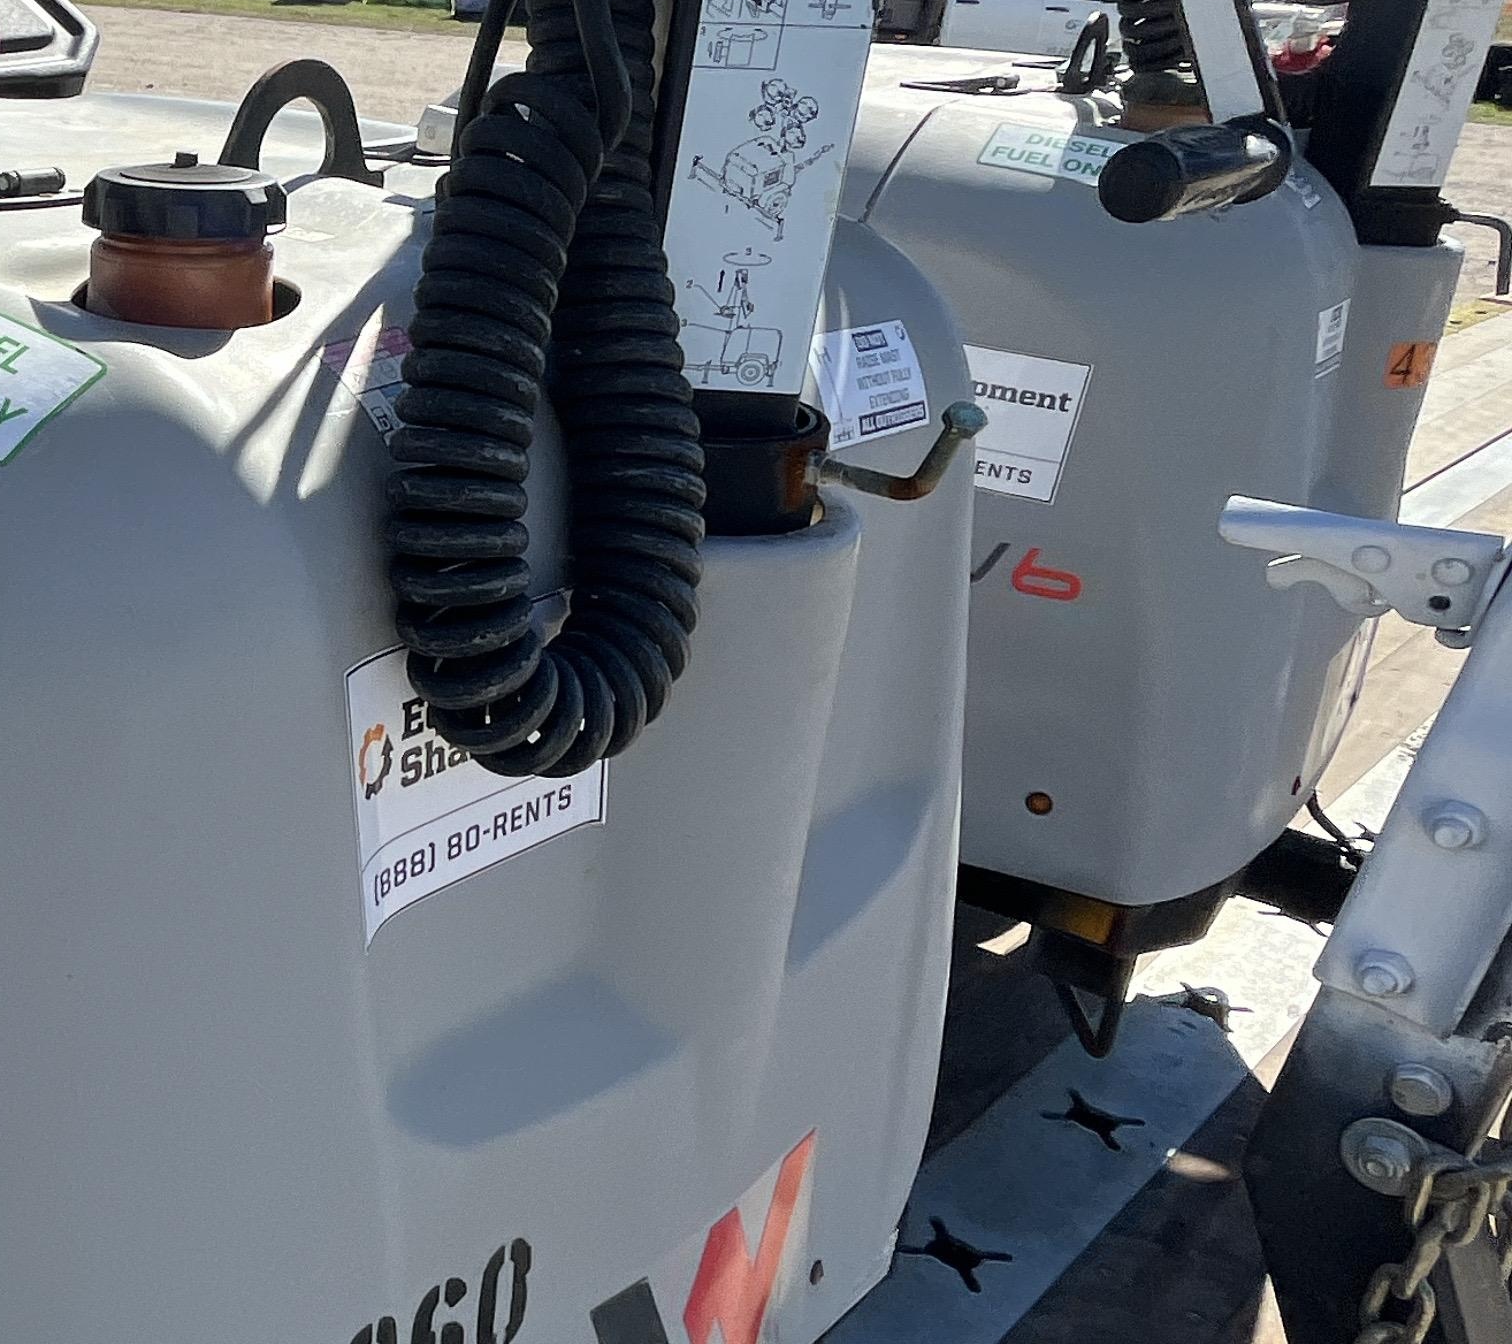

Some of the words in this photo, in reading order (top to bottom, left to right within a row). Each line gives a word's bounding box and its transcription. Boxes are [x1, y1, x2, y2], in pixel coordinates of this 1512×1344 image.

[992, 146, 1054, 167] FUEL
[1063, 158, 1103, 177] ON
[1025, 133, 1110, 157] DIESEL
[1389, 343, 1416, 385] 4
[400, 740, 471, 788] Sha
[374, 841, 436, 906] (888)
[447, 784, 572, 861] 80-RENTS
